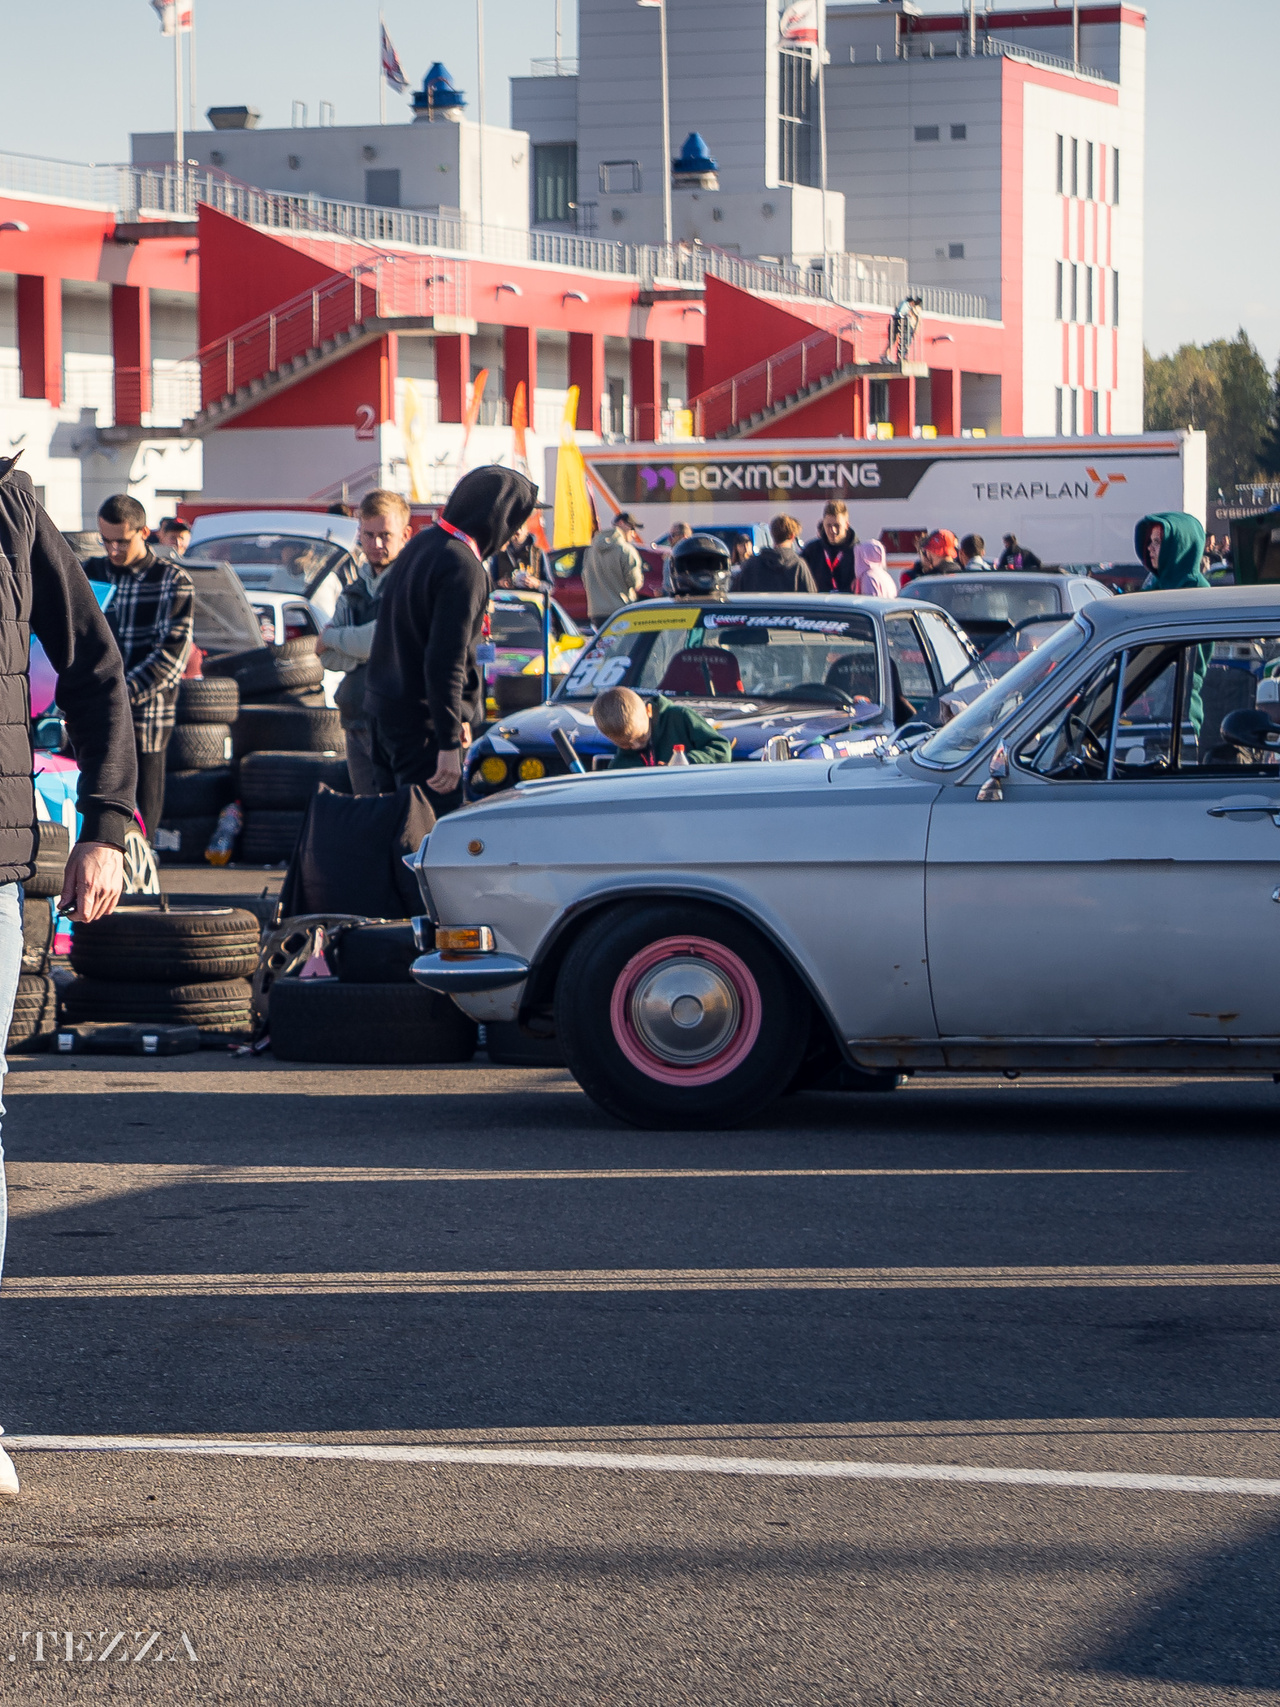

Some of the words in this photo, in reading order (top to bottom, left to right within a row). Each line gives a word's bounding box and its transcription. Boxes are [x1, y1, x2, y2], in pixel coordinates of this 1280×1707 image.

[356, 404, 376, 437] 2
[972, 481, 1089, 501] TERAPLAN
[566, 656, 631, 691] 56
